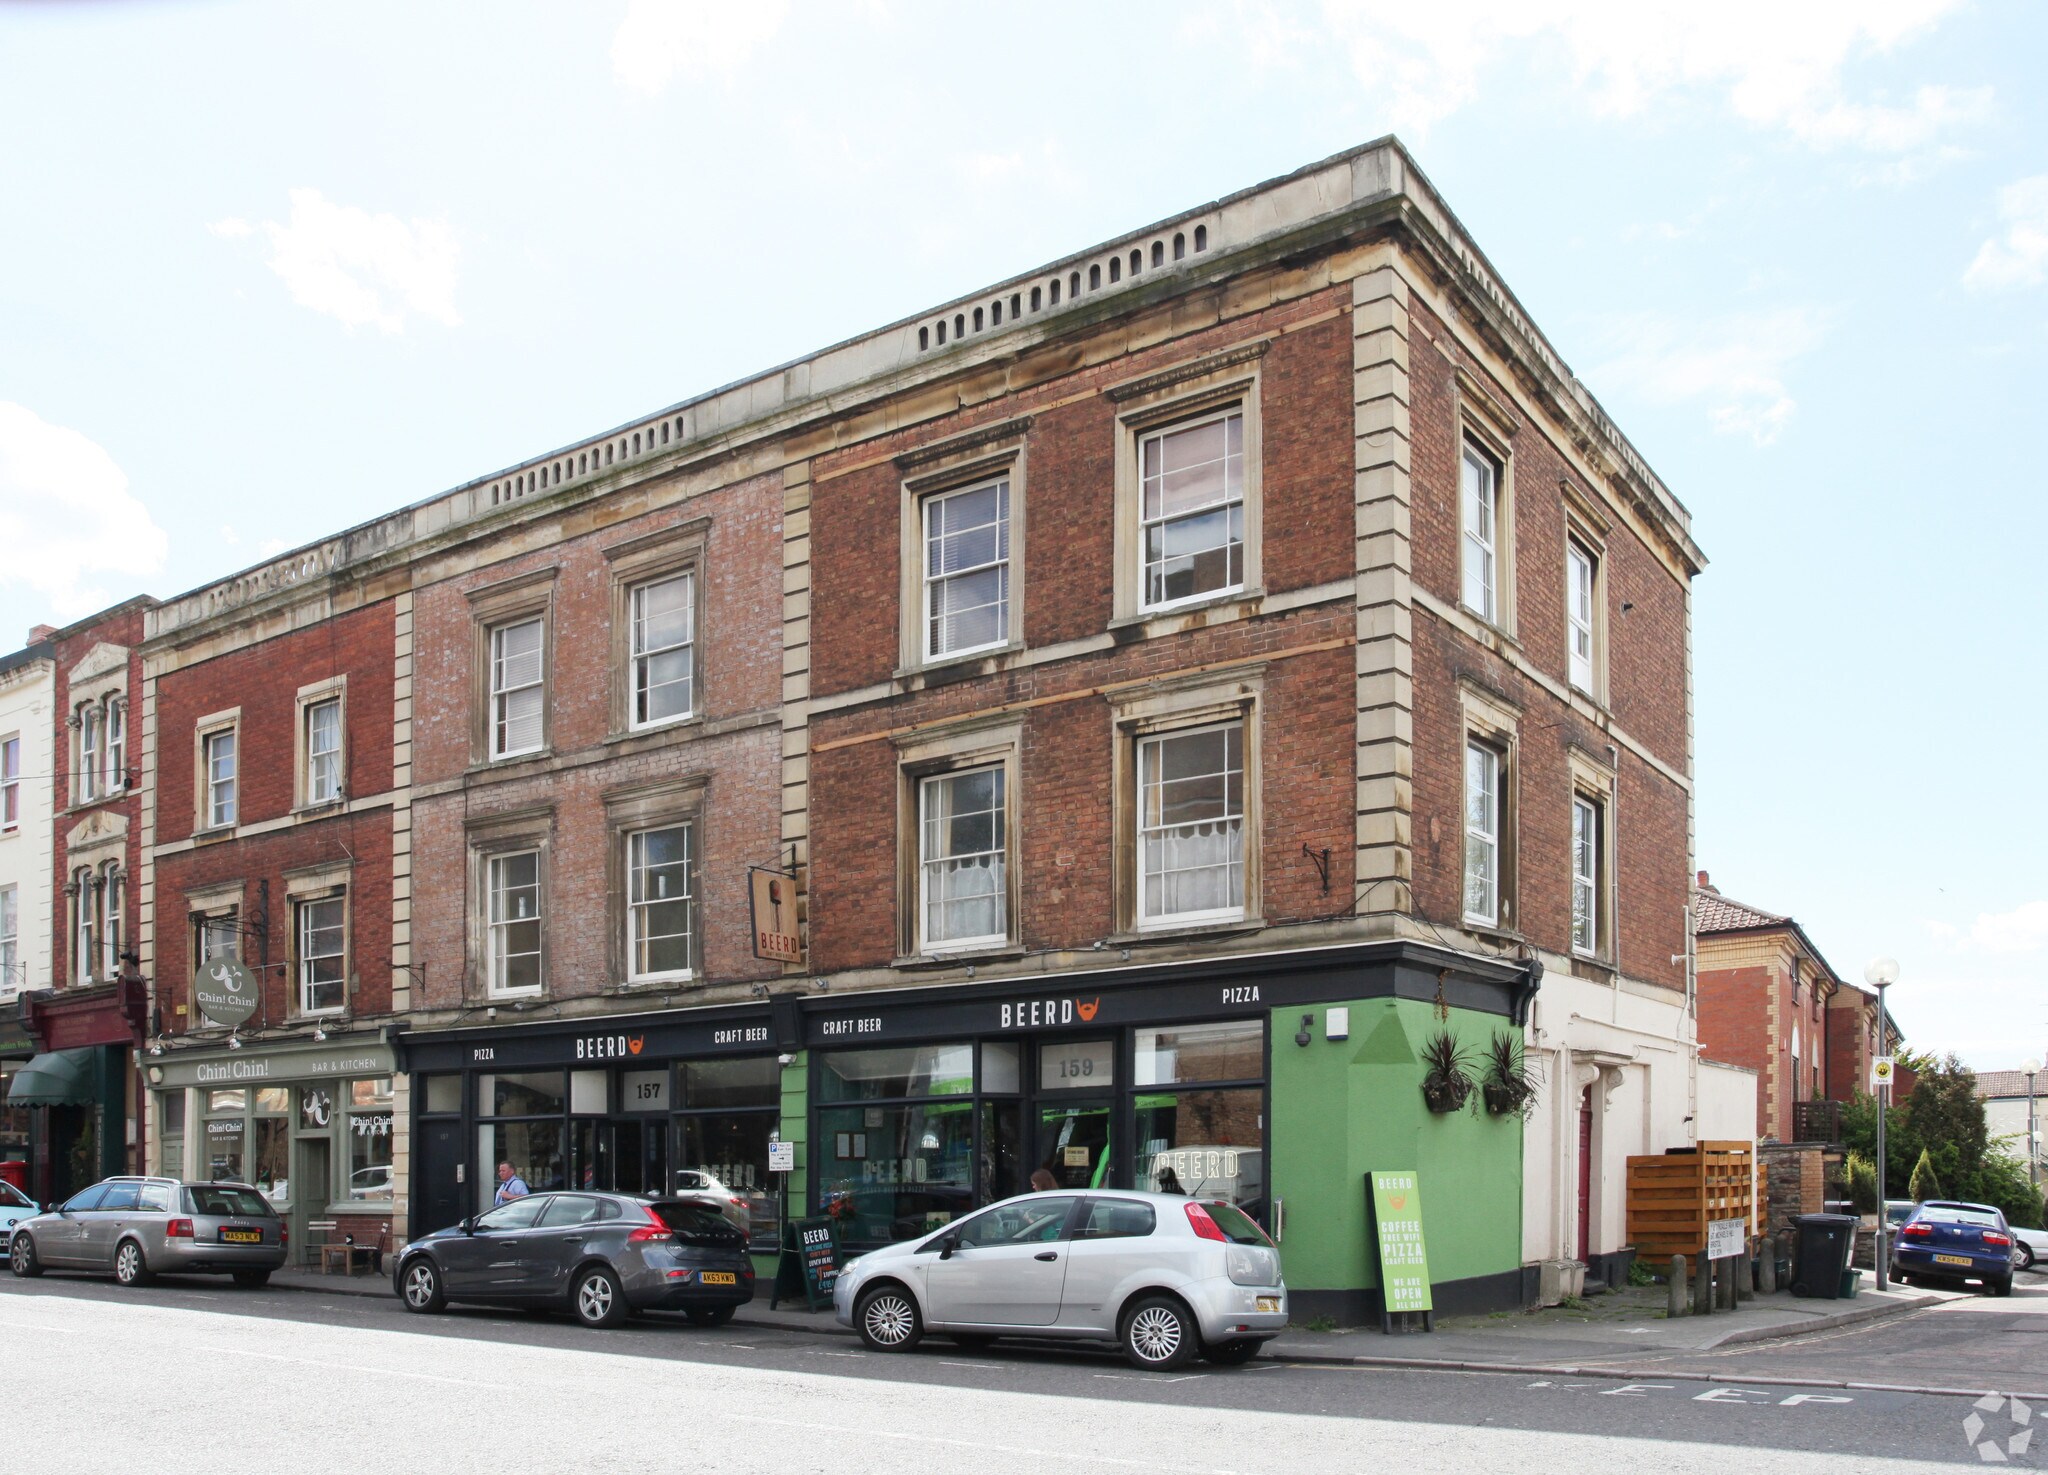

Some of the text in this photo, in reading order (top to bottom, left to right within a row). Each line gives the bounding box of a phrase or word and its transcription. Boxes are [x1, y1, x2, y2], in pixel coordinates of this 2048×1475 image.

[761, 932, 797, 954] BEERD
[198, 992, 255, 1007] Chin! Chin!
[1222, 986, 1260, 1004] PIZZA
[1001, 999, 1073, 1028] BEERD
[823, 1017, 882, 1035] CRAFT BEER
[714, 1027, 768, 1043] CRAFT BEER
[474, 1048, 494, 1061] PIZZA
[577, 1035, 626, 1059] BEERD
[197, 1059, 269, 1081] Chin! Chin!
[312, 1058, 377, 1073] BAR & KITCHEN
[1059, 1058, 1094, 1079] 159
[637, 1083, 661, 1099] 157
[208, 1122, 243, 1133] Chin! Chin!
[353, 1115, 393, 1127] Chin! Chin!
[771, 1144, 777, 1152] P
[516, 1166, 553, 1188] EERD
[700, 1164, 755, 1187] BEERD
[862, 1158, 927, 1184] BEERD
[1378, 1177, 1412, 1190] BEERD
[1381, 1221, 1420, 1233] COFFEE
[803, 1228, 829, 1245] BEERD
[1382, 1232, 1421, 1242] FREE WIFI
[1384, 1243, 1423, 1257] PIZZA
[1385, 1256, 1424, 1265] CRAFT BEER
[703, 1273, 719, 1282] AK63
[1393, 1277, 1421, 1286] WE ARE
[1394, 1288, 1422, 1300] OPEN
[1410, 1301, 1423, 1309] DAY
